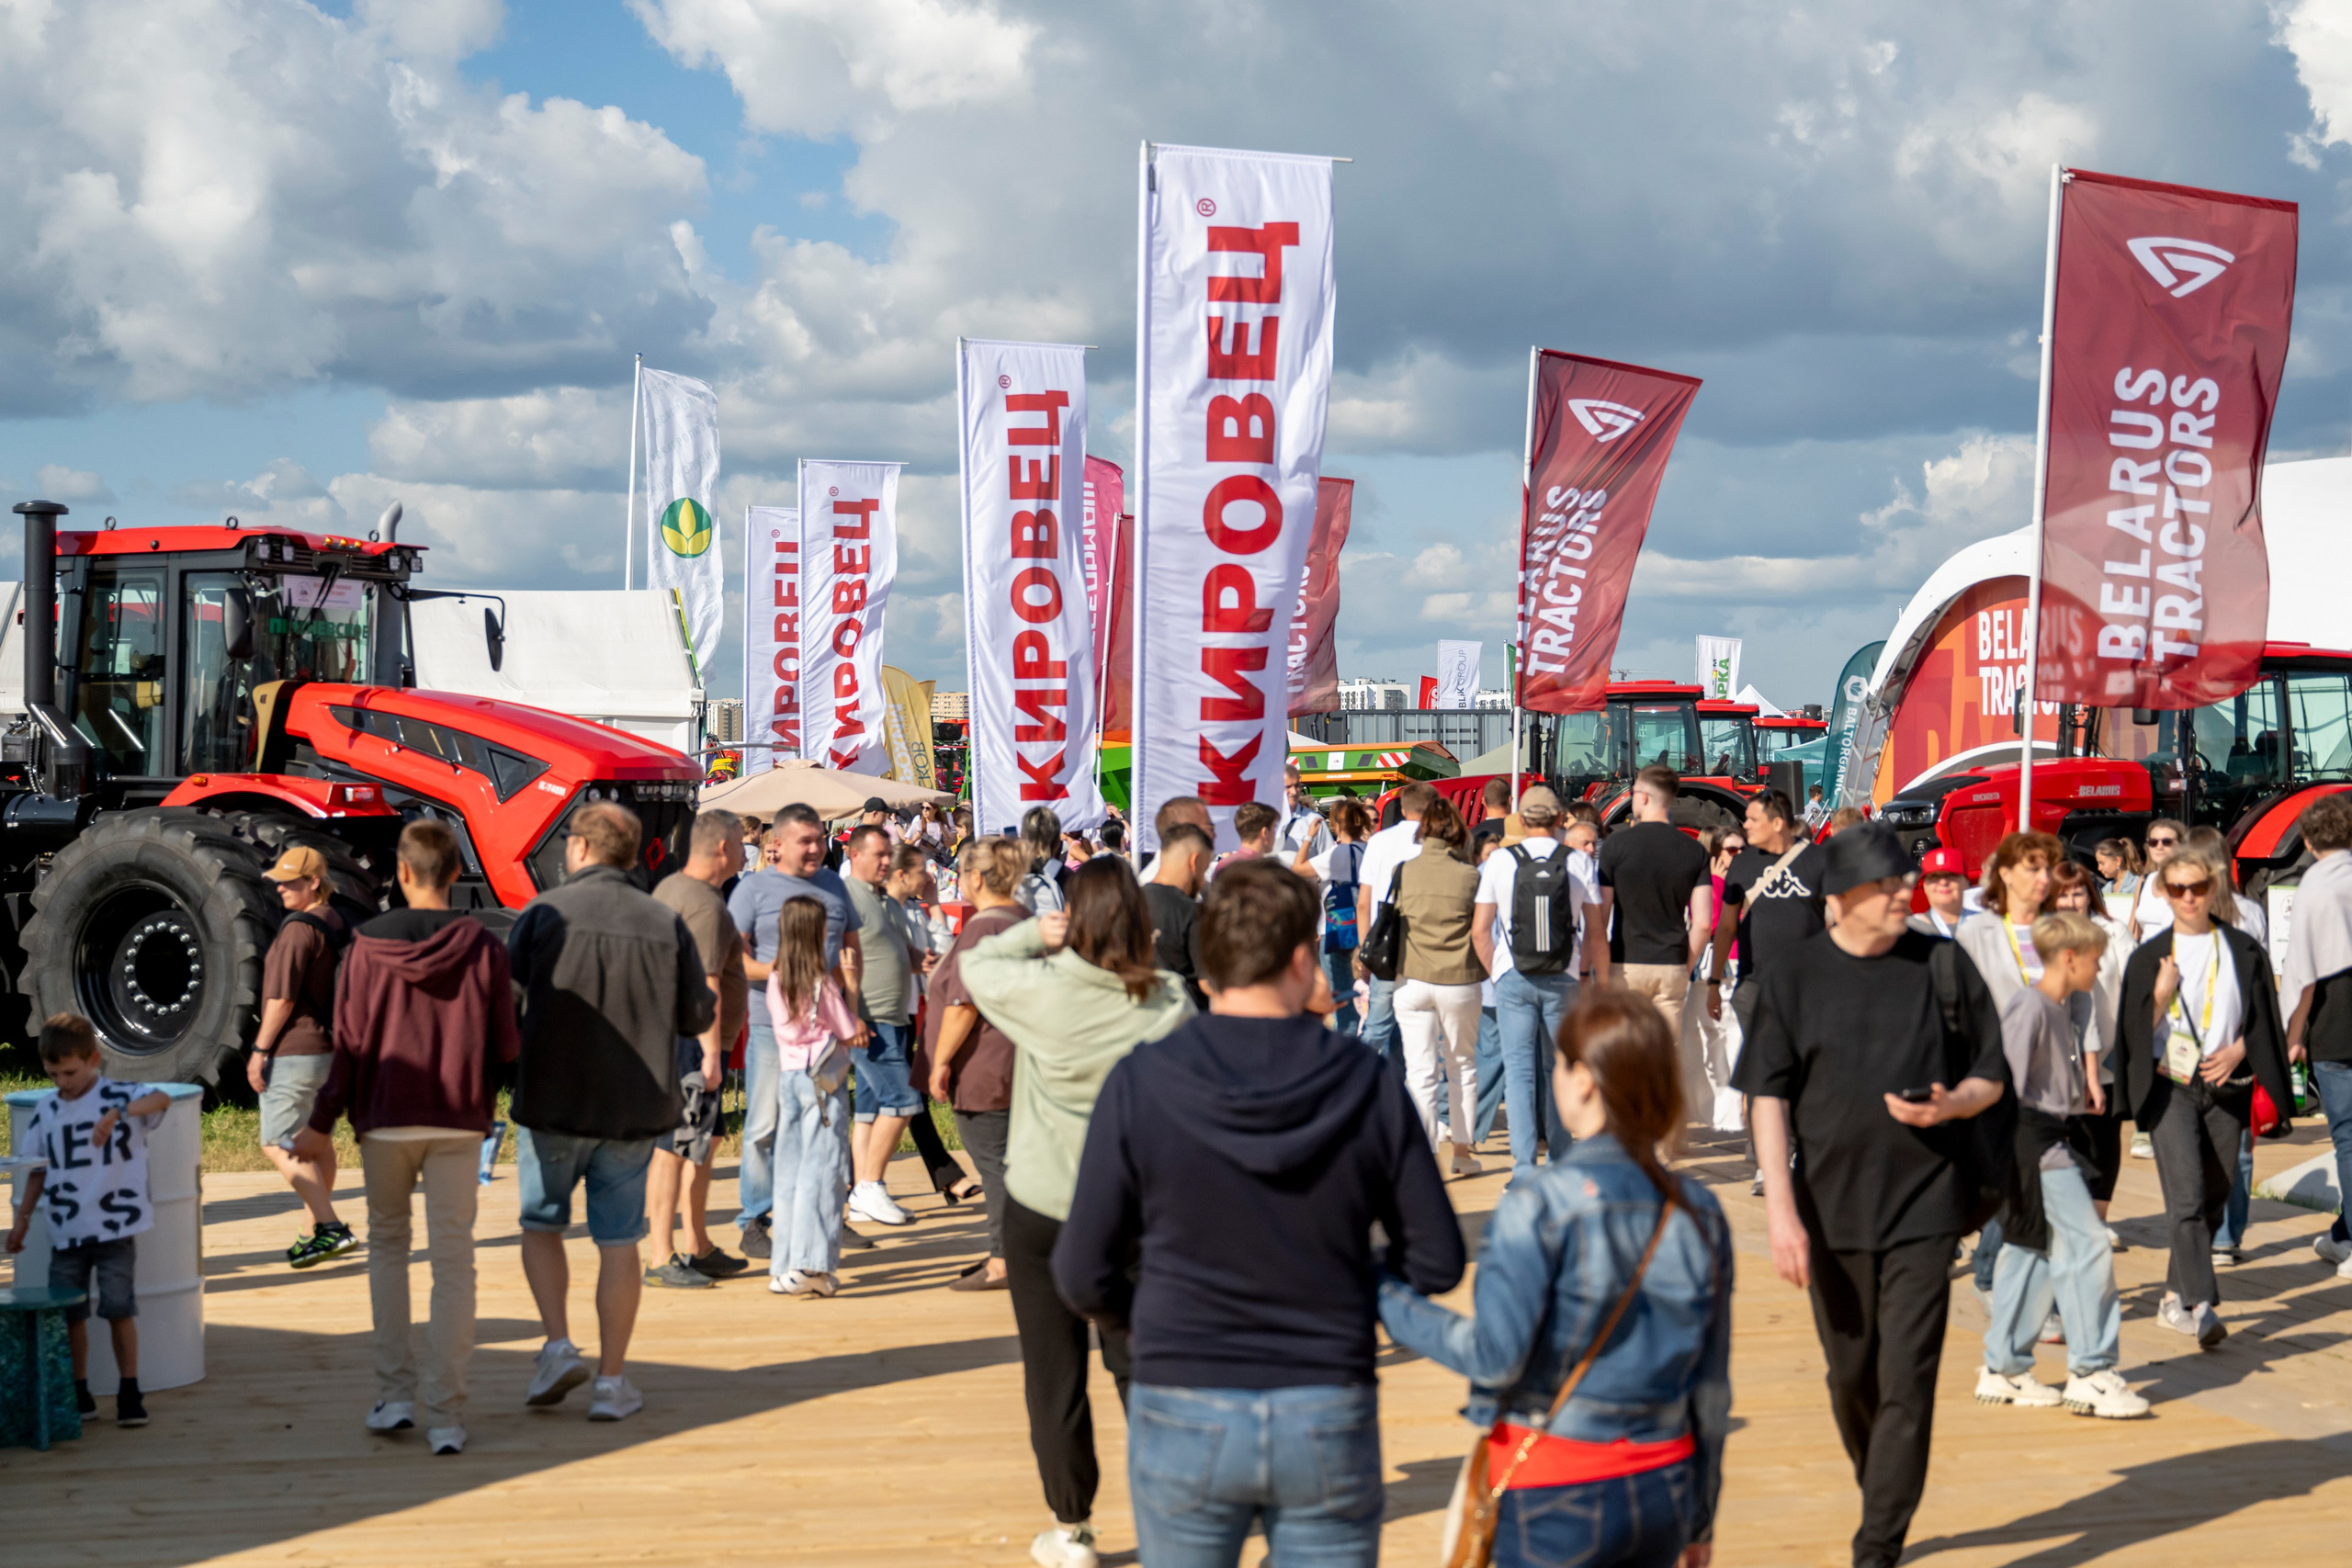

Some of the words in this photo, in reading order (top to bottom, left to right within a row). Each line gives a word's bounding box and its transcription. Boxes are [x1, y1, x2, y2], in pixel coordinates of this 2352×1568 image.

[1526, 488, 1608, 678] TRACTORS
[2098, 367, 2167, 660] BELARUS
[2153, 375, 2220, 662] TRACTORS
[638, 784, 685, 795] КИРОВЕЦ
[1834, 706, 1858, 796] BALTORGANIC
[2078, 784, 2120, 796] BELARUS
